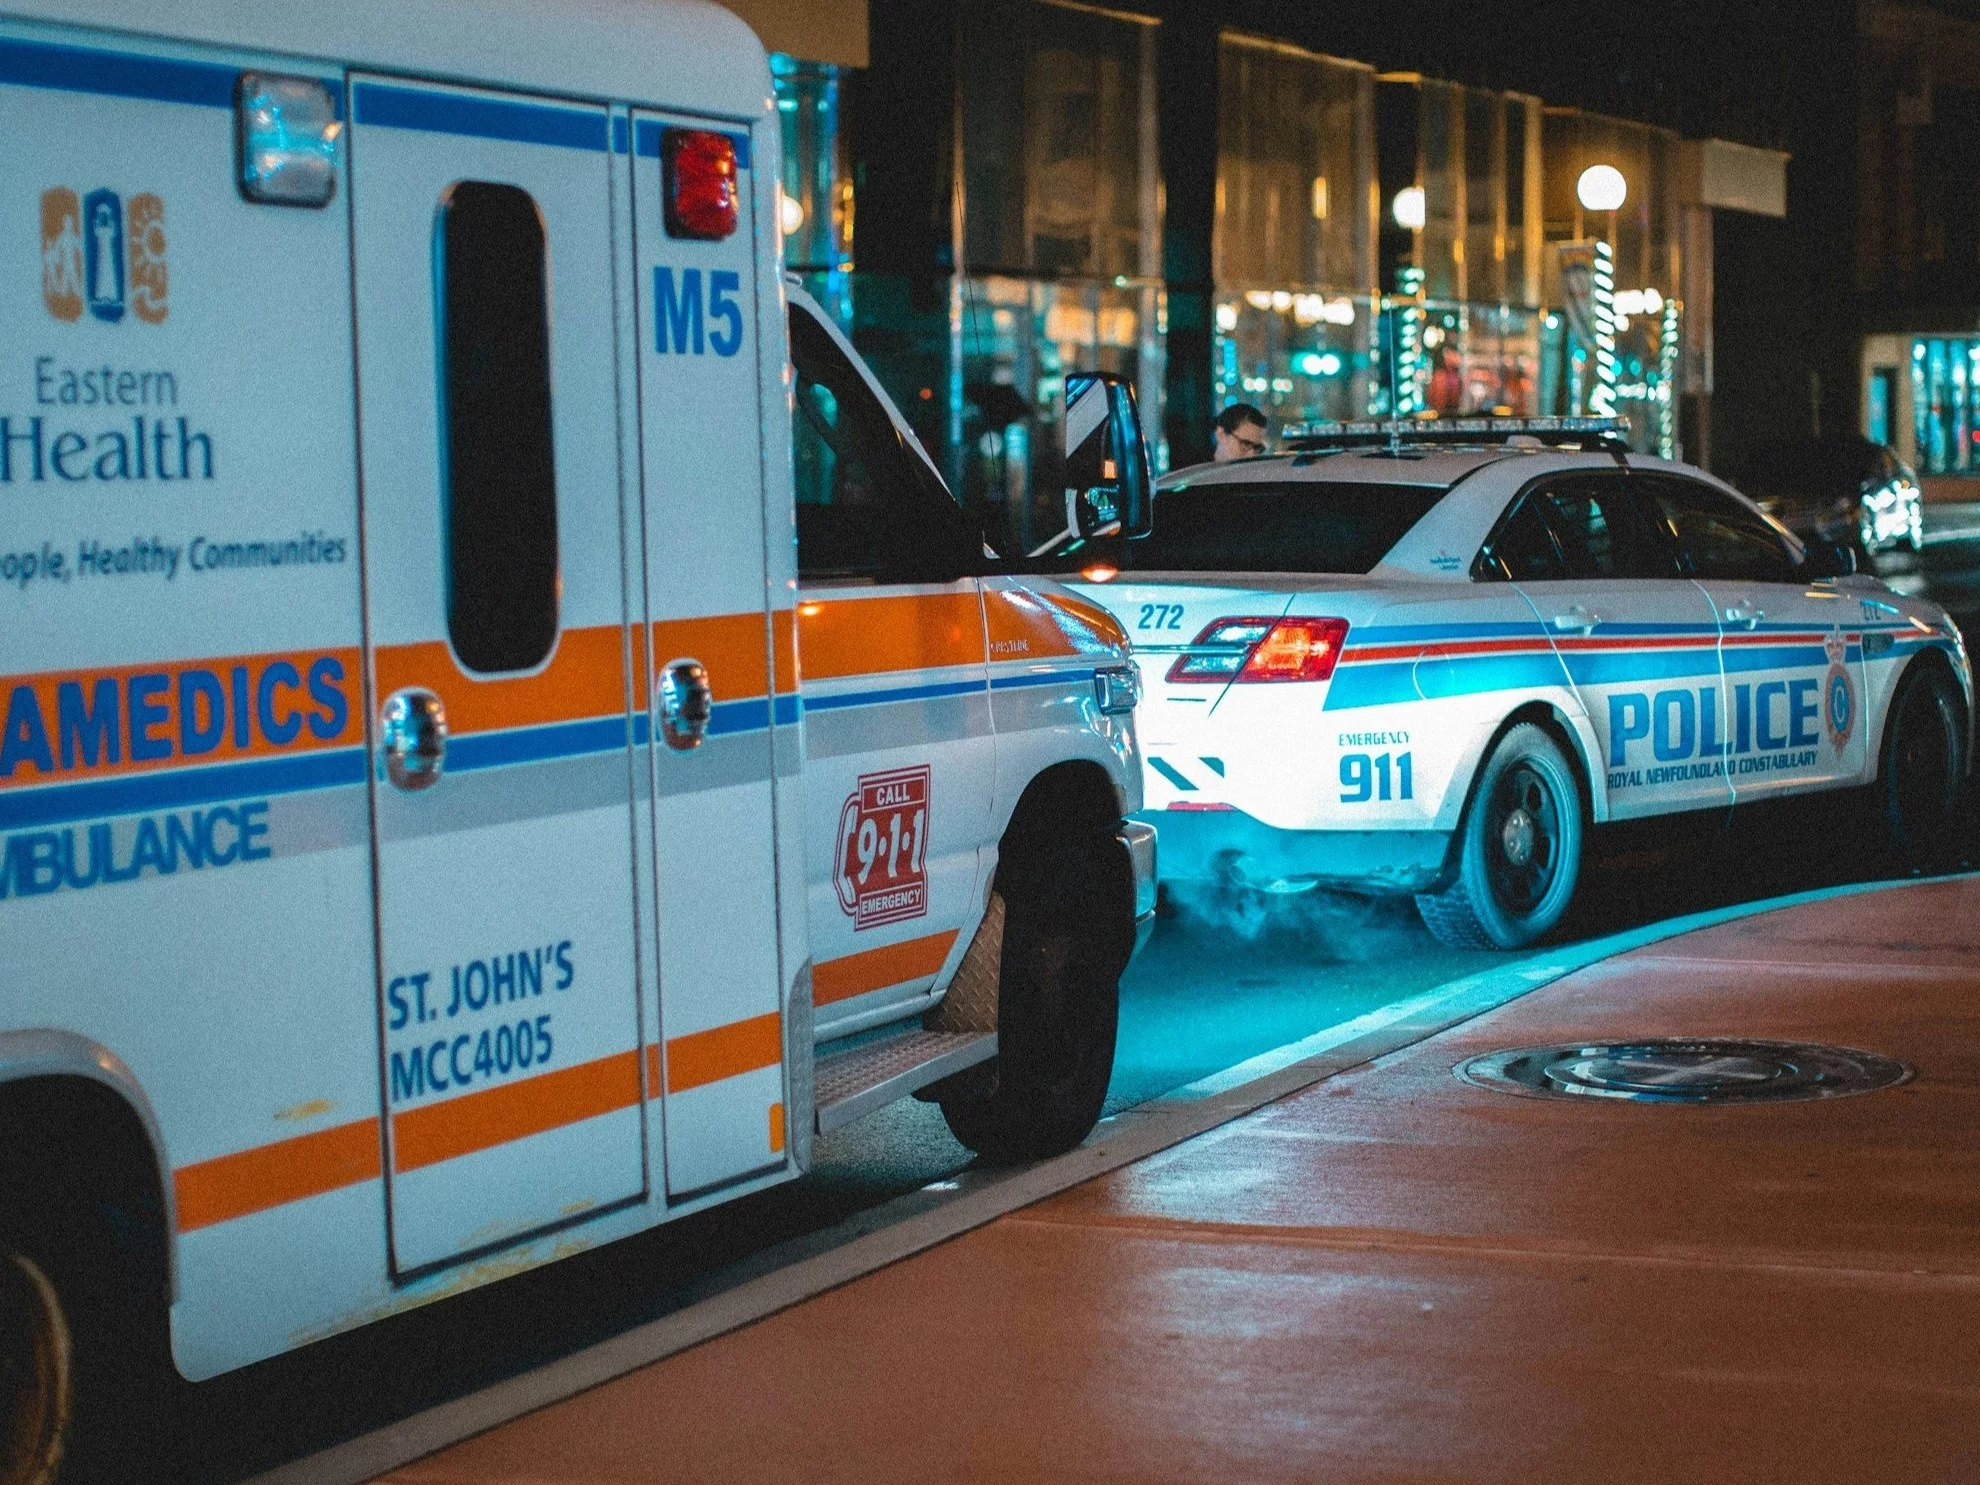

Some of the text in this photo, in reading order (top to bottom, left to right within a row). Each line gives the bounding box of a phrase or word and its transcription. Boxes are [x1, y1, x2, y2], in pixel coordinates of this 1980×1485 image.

[654, 266, 743, 357] M5
[35, 356, 179, 405] Eastern
[0, 415, 215, 483] Health
[77, 536, 183, 580] Healthy
[188, 529, 347, 571] Communities
[1138, 603, 1185, 630] 272
[0, 657, 348, 778] AMEDICS
[1338, 731, 1411, 747] EMERGENCY
[1608, 678, 1820, 768] POLICE
[876, 783, 911, 806] CALL
[1339, 751, 1414, 804] 911
[1607, 750, 1818, 790] ROYAL NEWFOUNDLAND CONSTABULARY
[861, 888, 922, 915] EMERGENCY
[387, 940, 575, 1031] ST. JOHN'S
[390, 1013, 554, 1104] MCC4005
